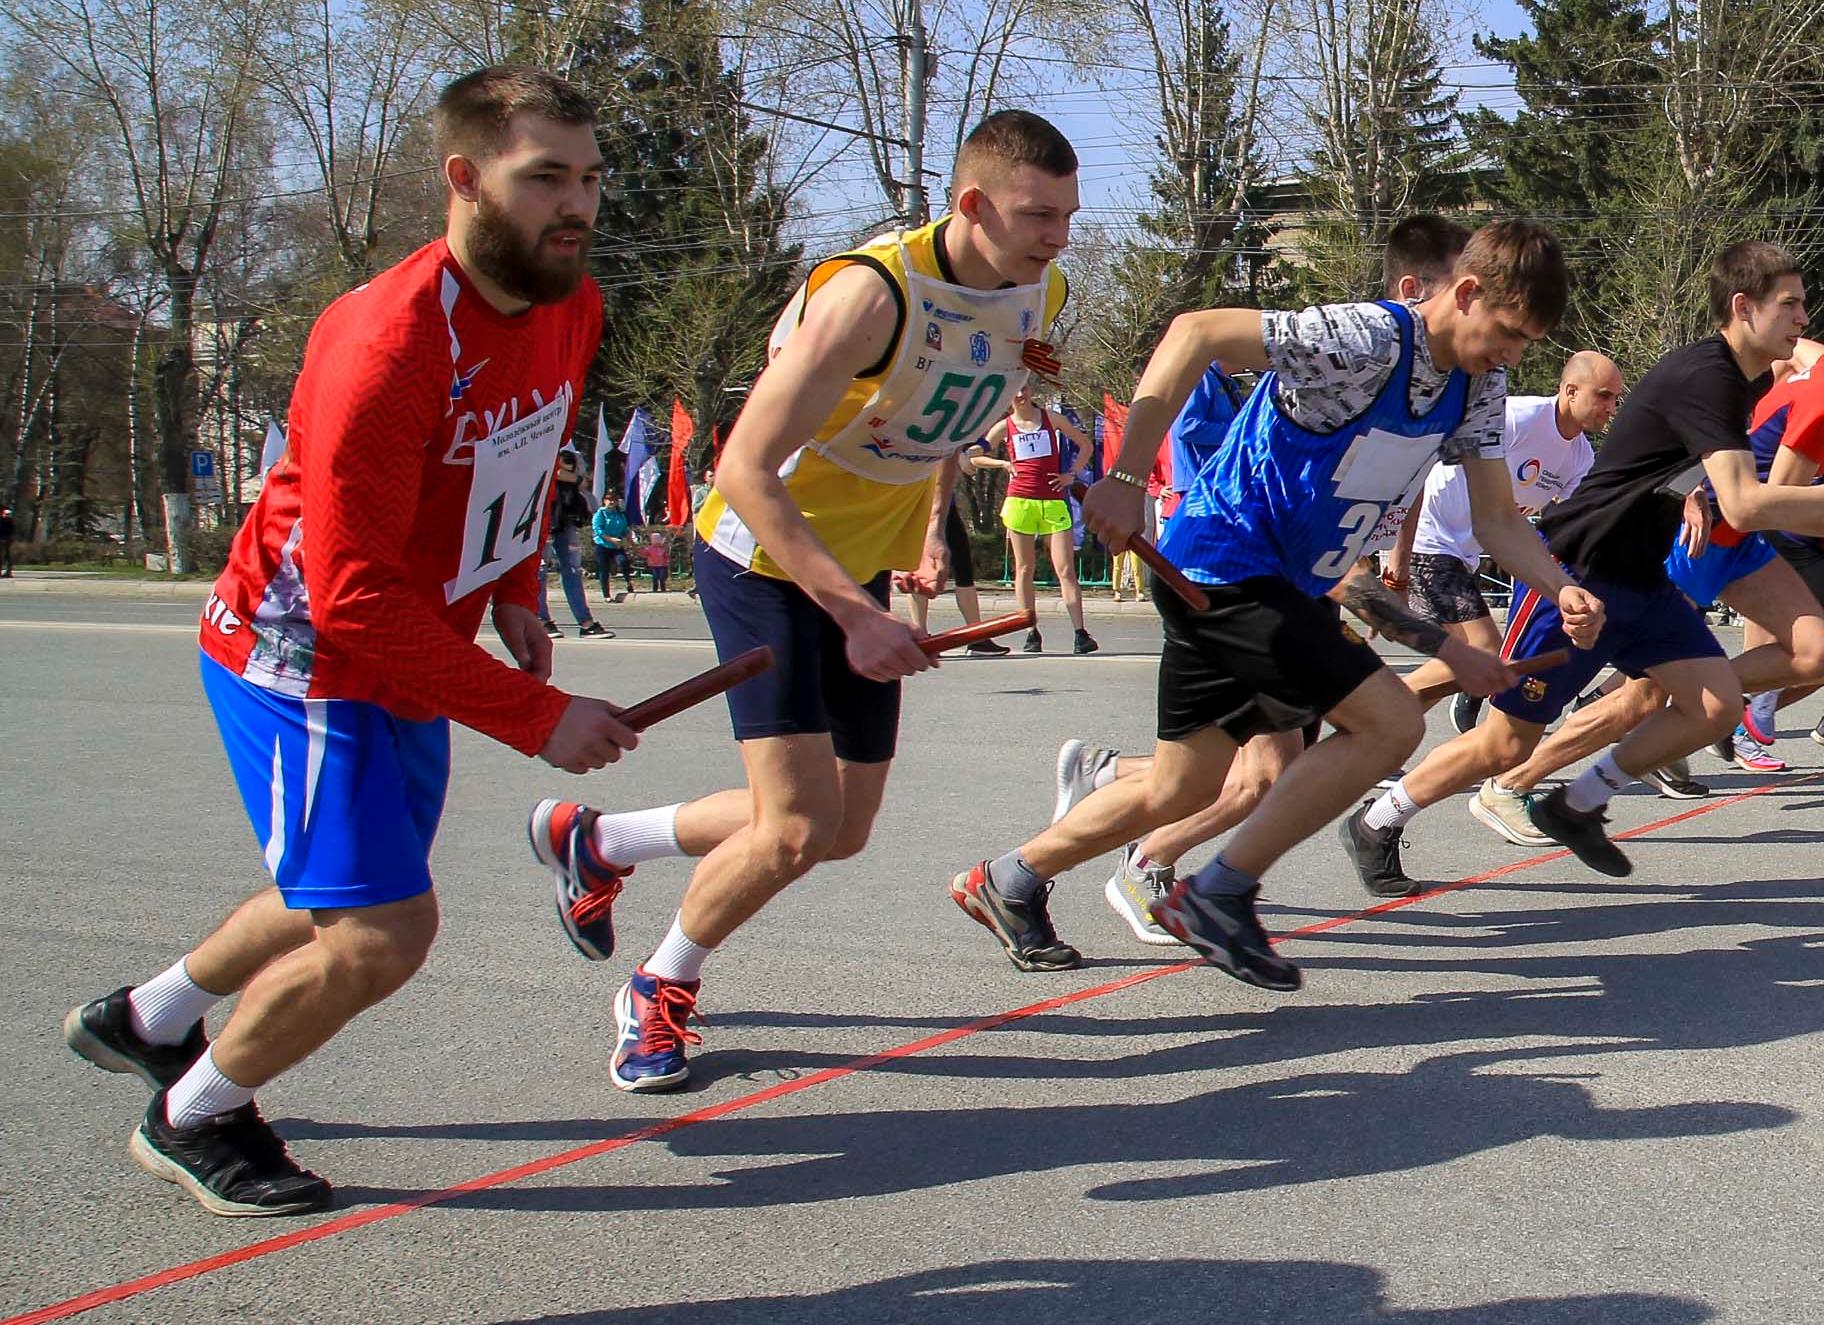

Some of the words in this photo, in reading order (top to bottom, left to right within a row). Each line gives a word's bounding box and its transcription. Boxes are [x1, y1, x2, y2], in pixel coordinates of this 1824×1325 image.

[906, 371, 1008, 444] 50
[196, 454, 208, 474] P
[1028, 443, 1035, 452] 1
[473, 470, 548, 572] 14
[1311, 503, 1381, 578] 3
